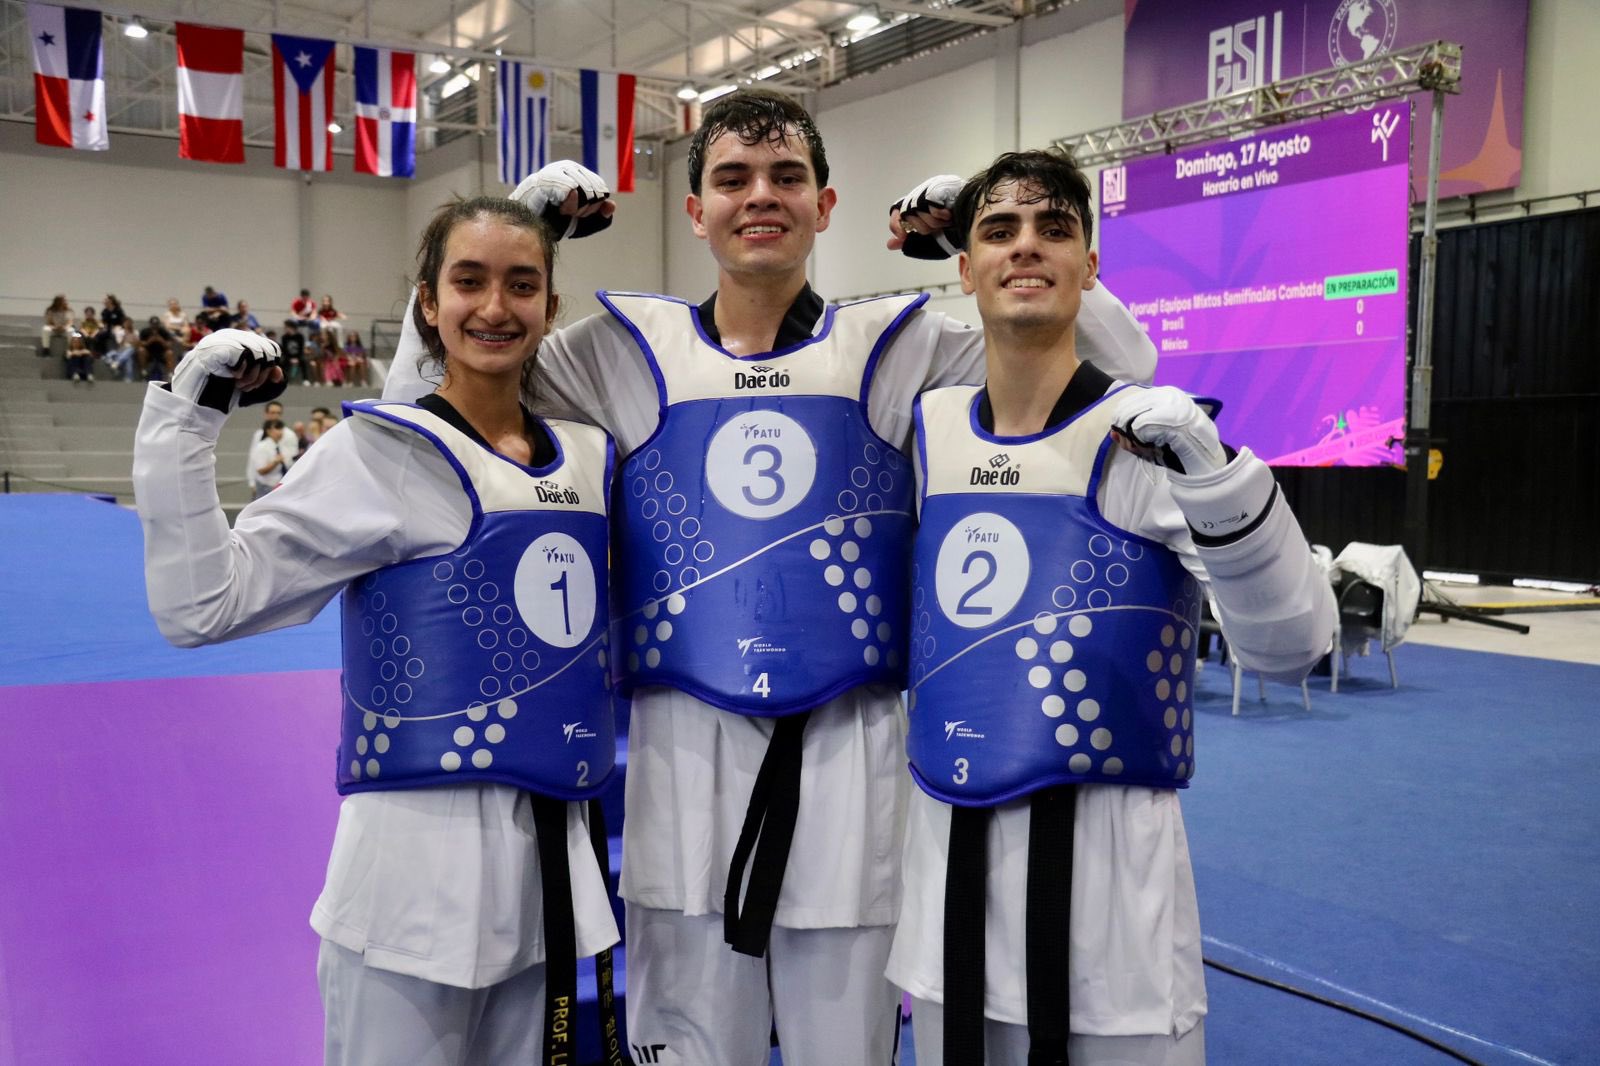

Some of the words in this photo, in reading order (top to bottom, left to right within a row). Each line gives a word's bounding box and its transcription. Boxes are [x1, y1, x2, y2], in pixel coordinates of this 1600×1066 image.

[1176, 152, 1238, 179] Domingo,
[1240, 142, 1256, 166] 17
[1258, 134, 1311, 166] Agosto
[1202, 176, 1239, 197] Horario
[1240, 175, 1254, 189] en
[1254, 169, 1279, 186] Vivo
[1326, 282, 1336, 294] EN
[1339, 274, 1396, 292] PREPARACIÓN
[1160, 297, 1192, 315] Equipos
[1193, 293, 1221, 310] Mixtos
[1223, 286, 1277, 307] Semifinales
[1278, 282, 1323, 300] Combate
[1356, 298, 1364, 314] 0
[1161, 316, 1184, 331] Brasil
[1356, 320, 1364, 336] 0
[753, 428, 781, 439] PATU
[742, 443, 786, 506] 3
[974, 532, 1000, 543] PATU
[956, 550, 998, 615] 2
[551, 571, 572, 636] 1
[752, 672, 771, 698] 4
[576, 760, 589, 787] 2
[952, 757, 969, 785] 3
